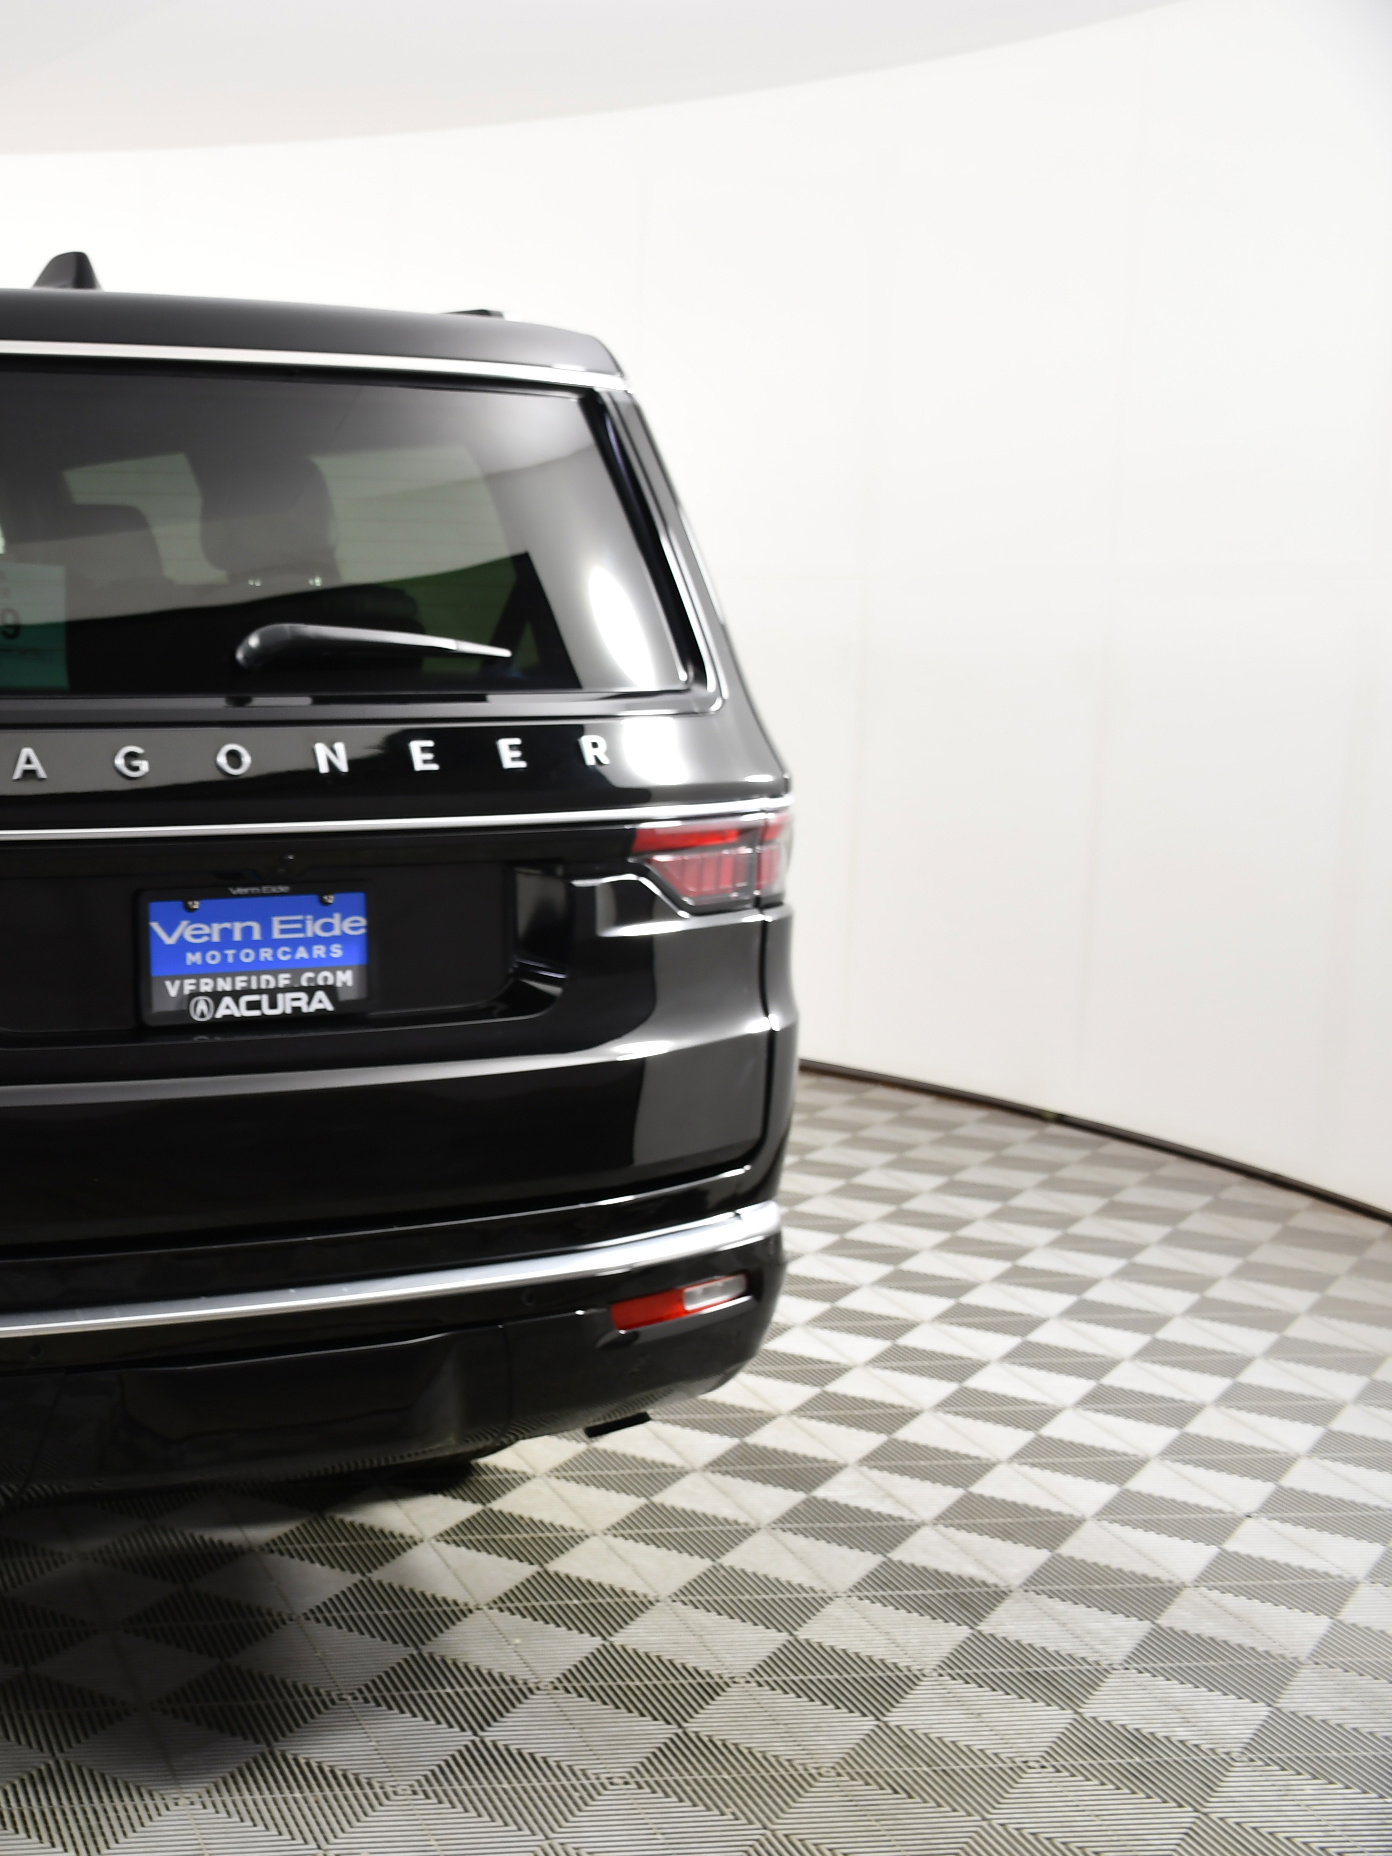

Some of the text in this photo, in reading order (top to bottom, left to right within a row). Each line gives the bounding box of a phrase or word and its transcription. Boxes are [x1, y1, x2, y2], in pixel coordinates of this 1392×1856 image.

[228, 884, 290, 896] Vern Eide
[149, 912, 368, 945] Vern Eide
[185, 943, 344, 966] MOTORCARS
[214, 990, 335, 1019] ACURA
